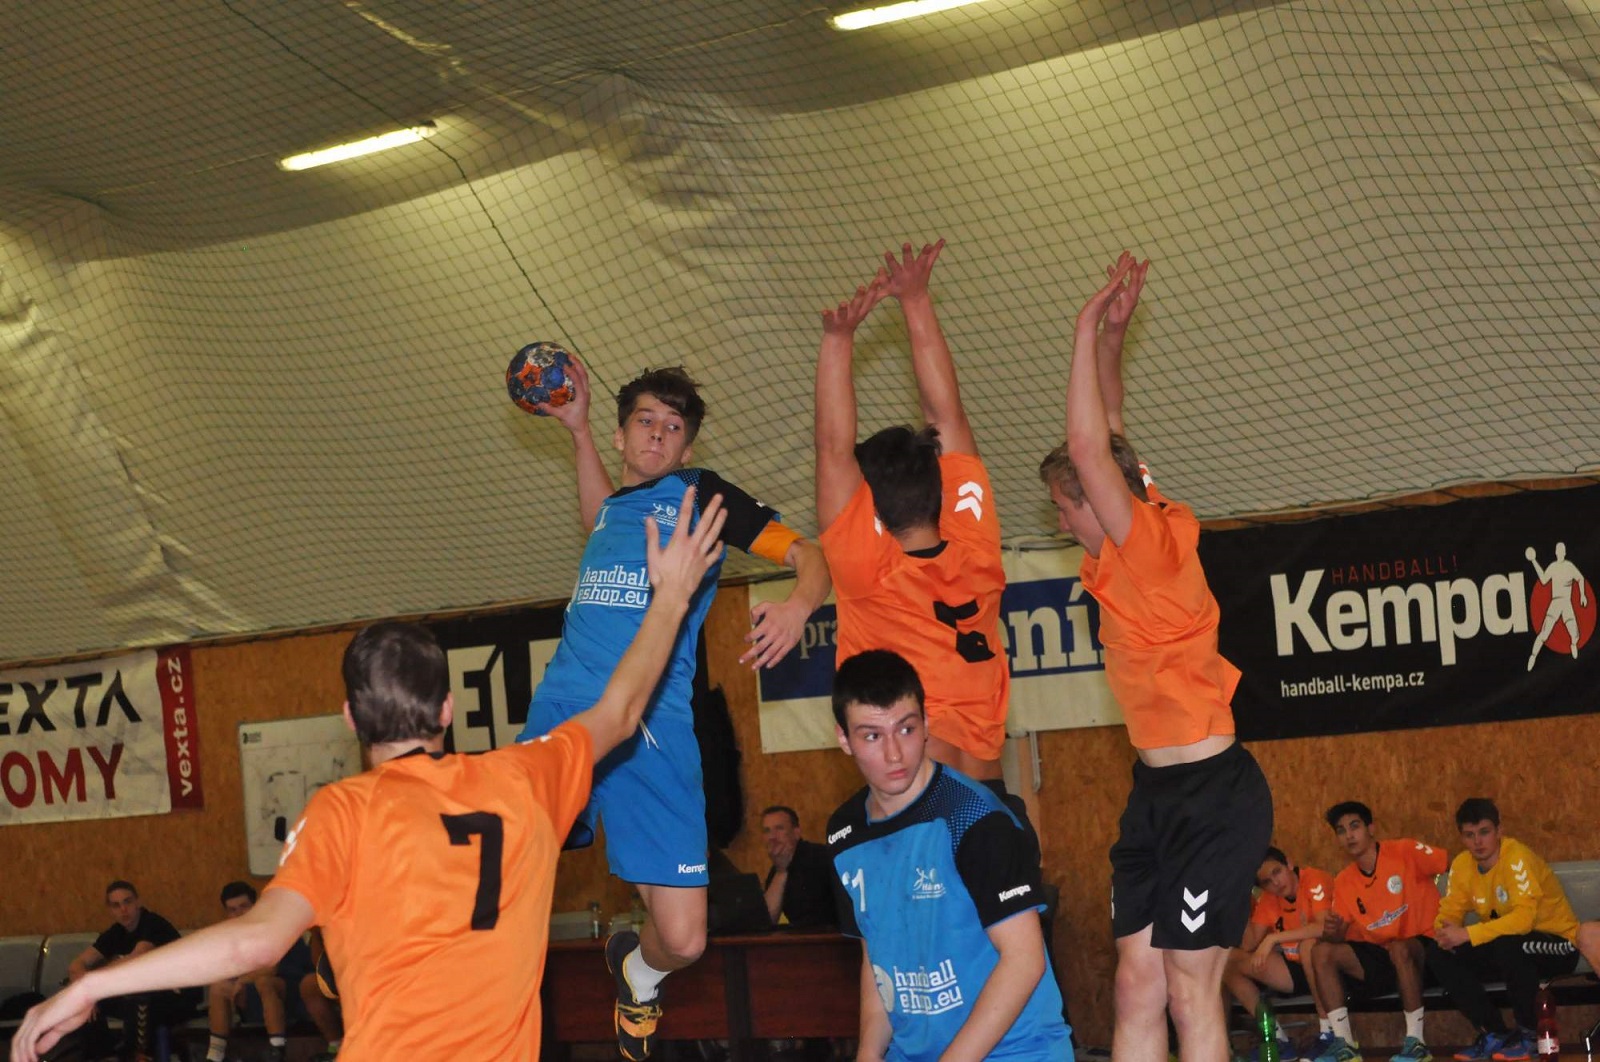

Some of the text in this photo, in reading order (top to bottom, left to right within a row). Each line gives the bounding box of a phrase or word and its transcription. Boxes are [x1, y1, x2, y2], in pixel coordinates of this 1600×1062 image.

[1331, 555, 1459, 585] HANDBALL!
[1270, 569, 1529, 666] Kempa
[800, 620, 837, 660] pr
[1280, 671, 1425, 698] handball-kempa.cz
[167, 656, 193, 796] vexta.cz
[440, 811, 504, 931] 7
[998, 884, 1031, 902] Kempa
